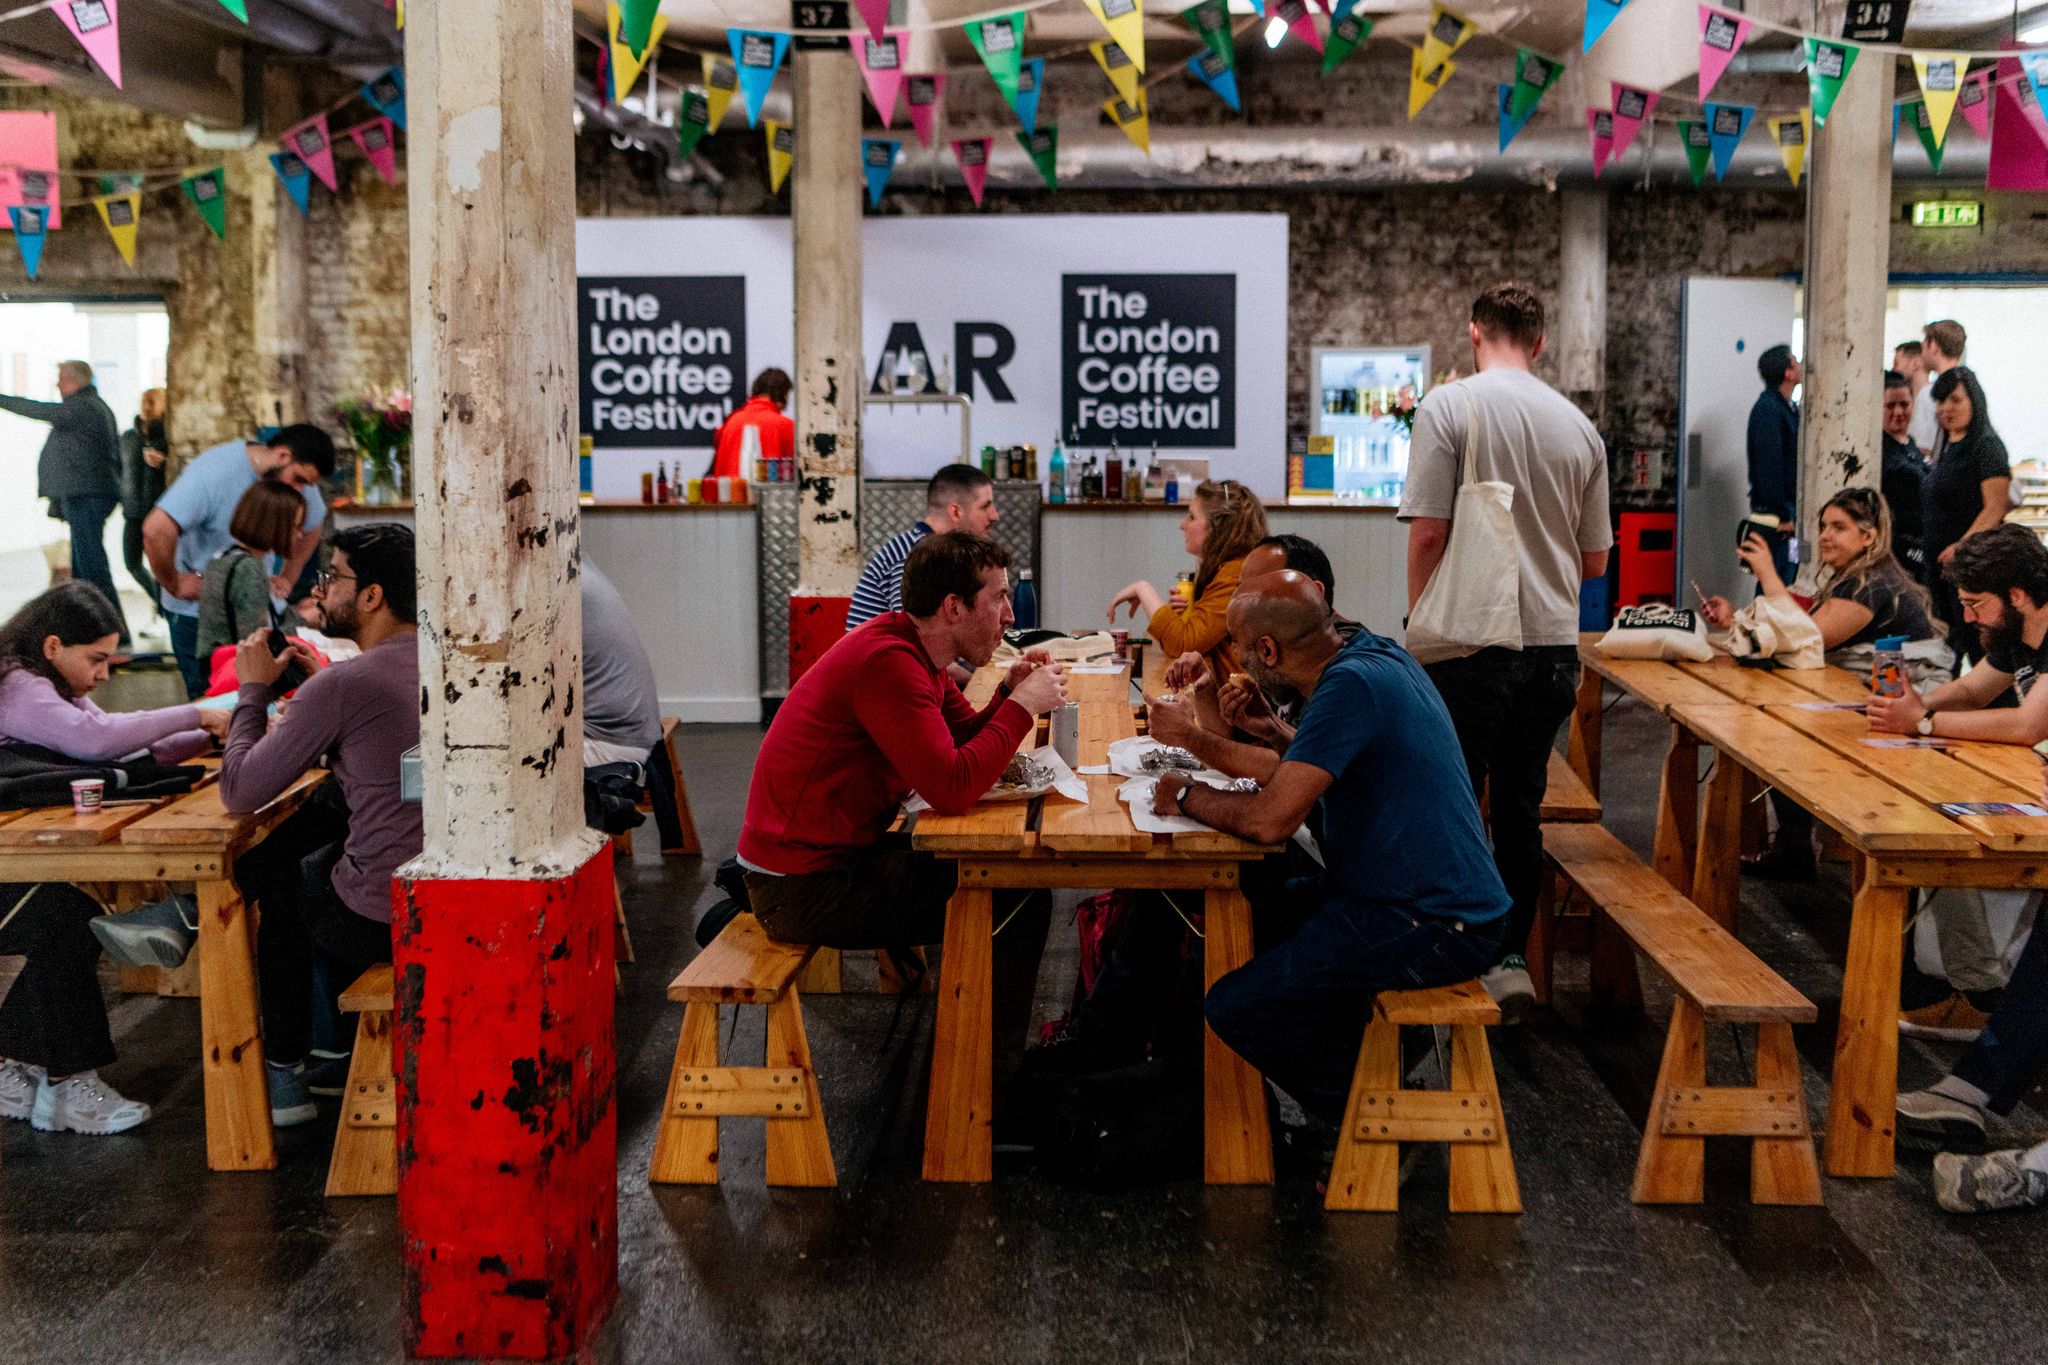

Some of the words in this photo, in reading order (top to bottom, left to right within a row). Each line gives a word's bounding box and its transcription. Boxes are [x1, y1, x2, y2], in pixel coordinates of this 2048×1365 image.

[801, 6, 833, 27] 37
[1856, 3, 1892, 25] 38
[589, 288, 660, 321] The
[1077, 286, 1148, 319] The
[590, 321, 732, 355] London
[1078, 320, 1220, 353] London
[591, 356, 733, 395] Coffee
[1078, 356, 1220, 393] Coffee
[592, 396, 733, 430] Festival
[1079, 396, 1220, 430] Festival
